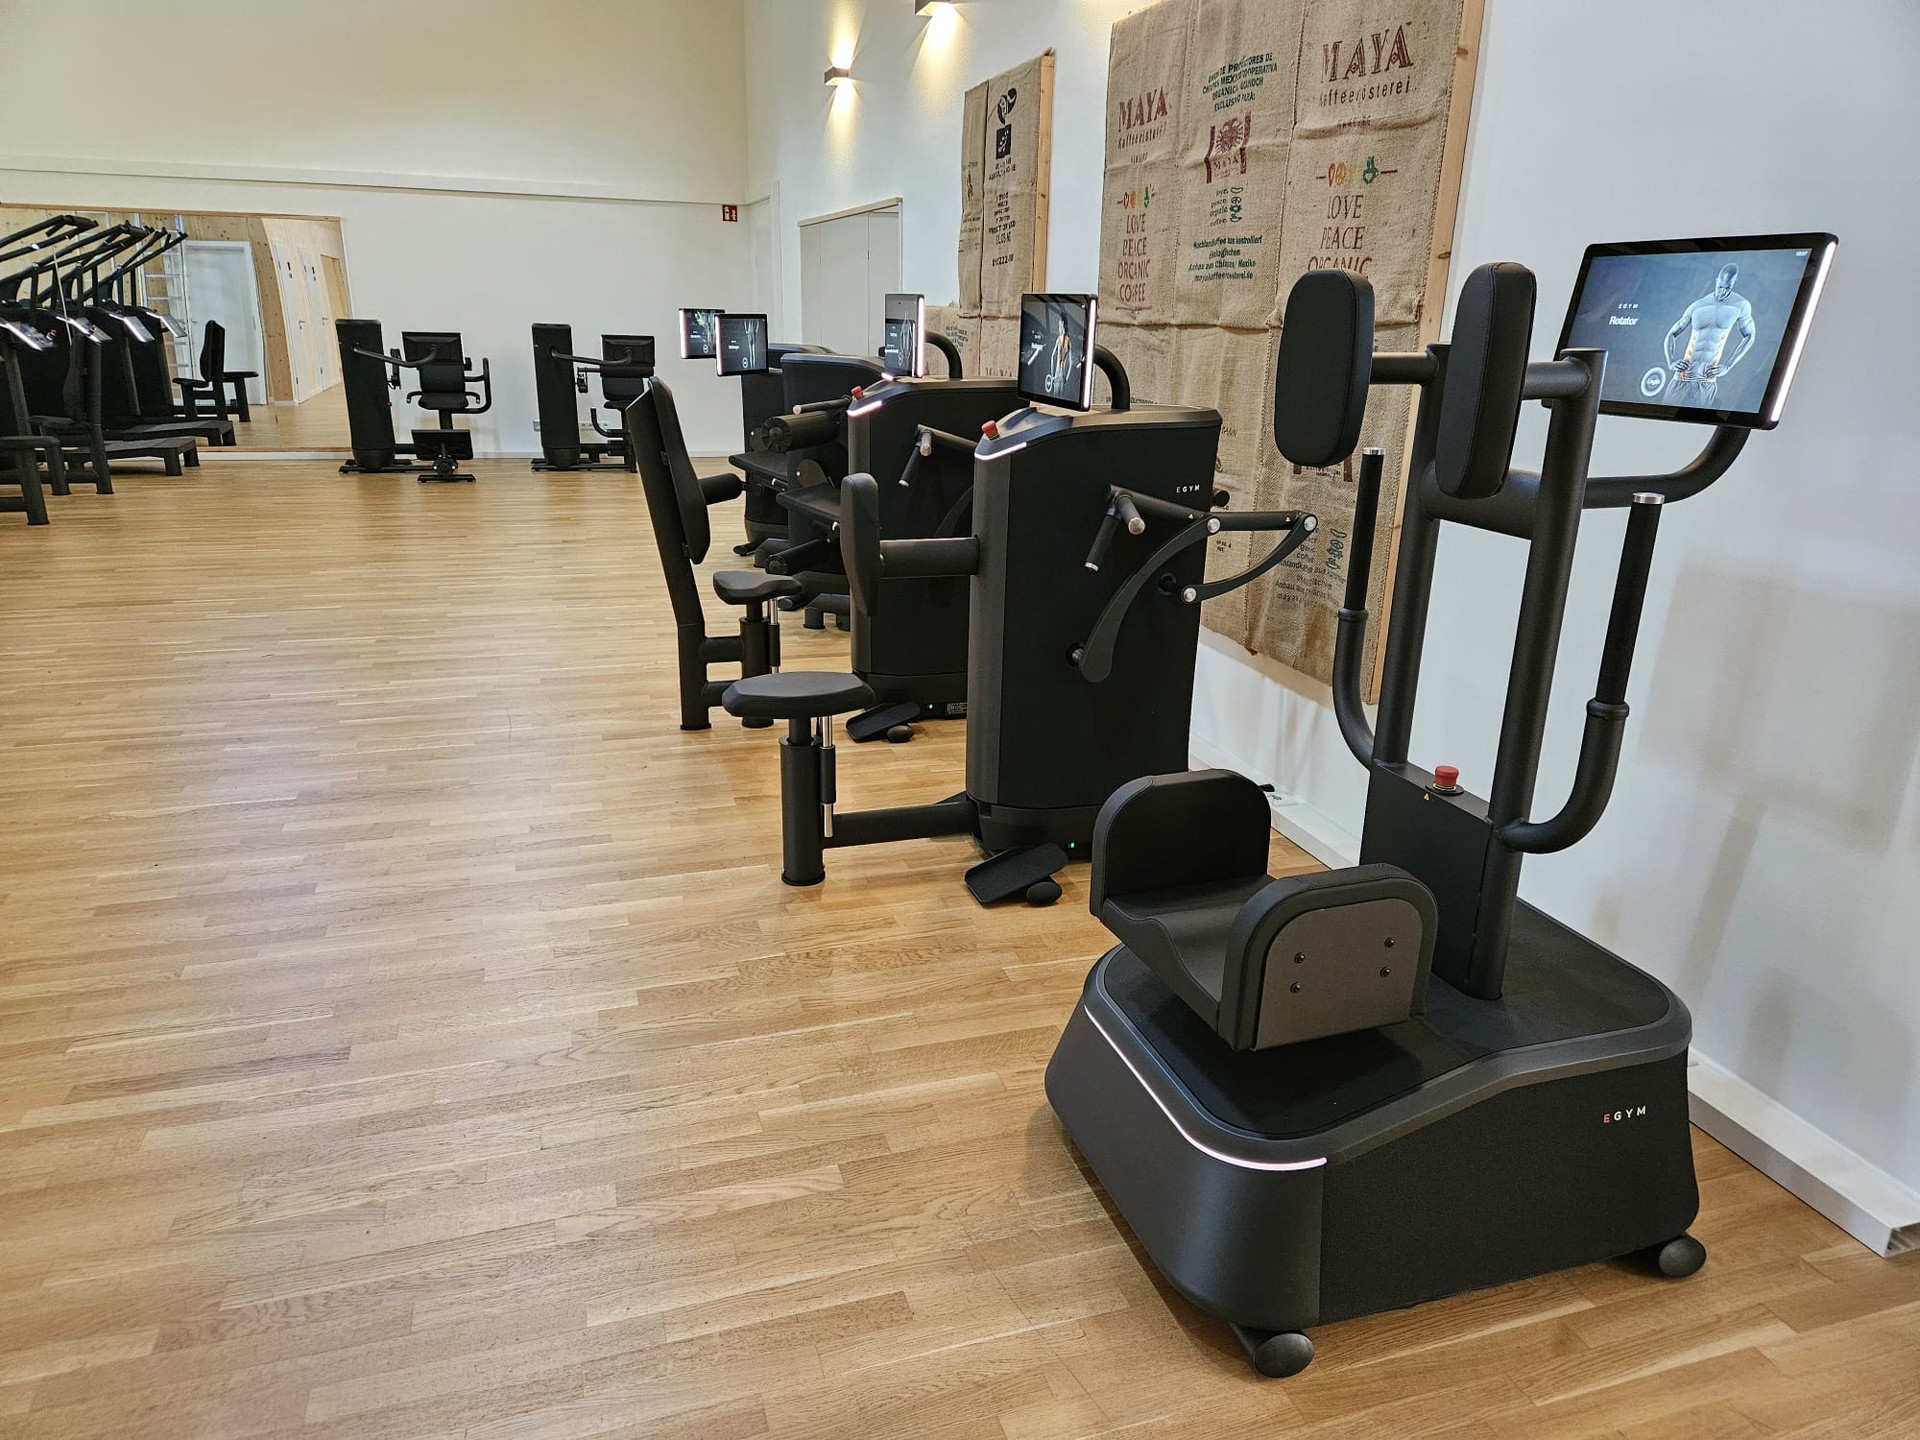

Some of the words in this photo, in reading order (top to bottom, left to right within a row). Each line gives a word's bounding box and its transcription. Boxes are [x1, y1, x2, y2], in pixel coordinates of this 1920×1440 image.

[1265, 52, 1274, 62] DE
[1321, 25, 1413, 83] MAYA
[1118, 84, 1168, 133] MAYA
[1327, 193, 1364, 220] LOVE
[1126, 213, 1146, 234] LOVE
[1320, 226, 1366, 250] PEACE
[1117, 259, 1151, 280] ORGANIC
[1608, 315, 1639, 326] Rotator
[1176, 484, 1200, 494] EGYM
[1603, 1105, 1647, 1124] EGYM
